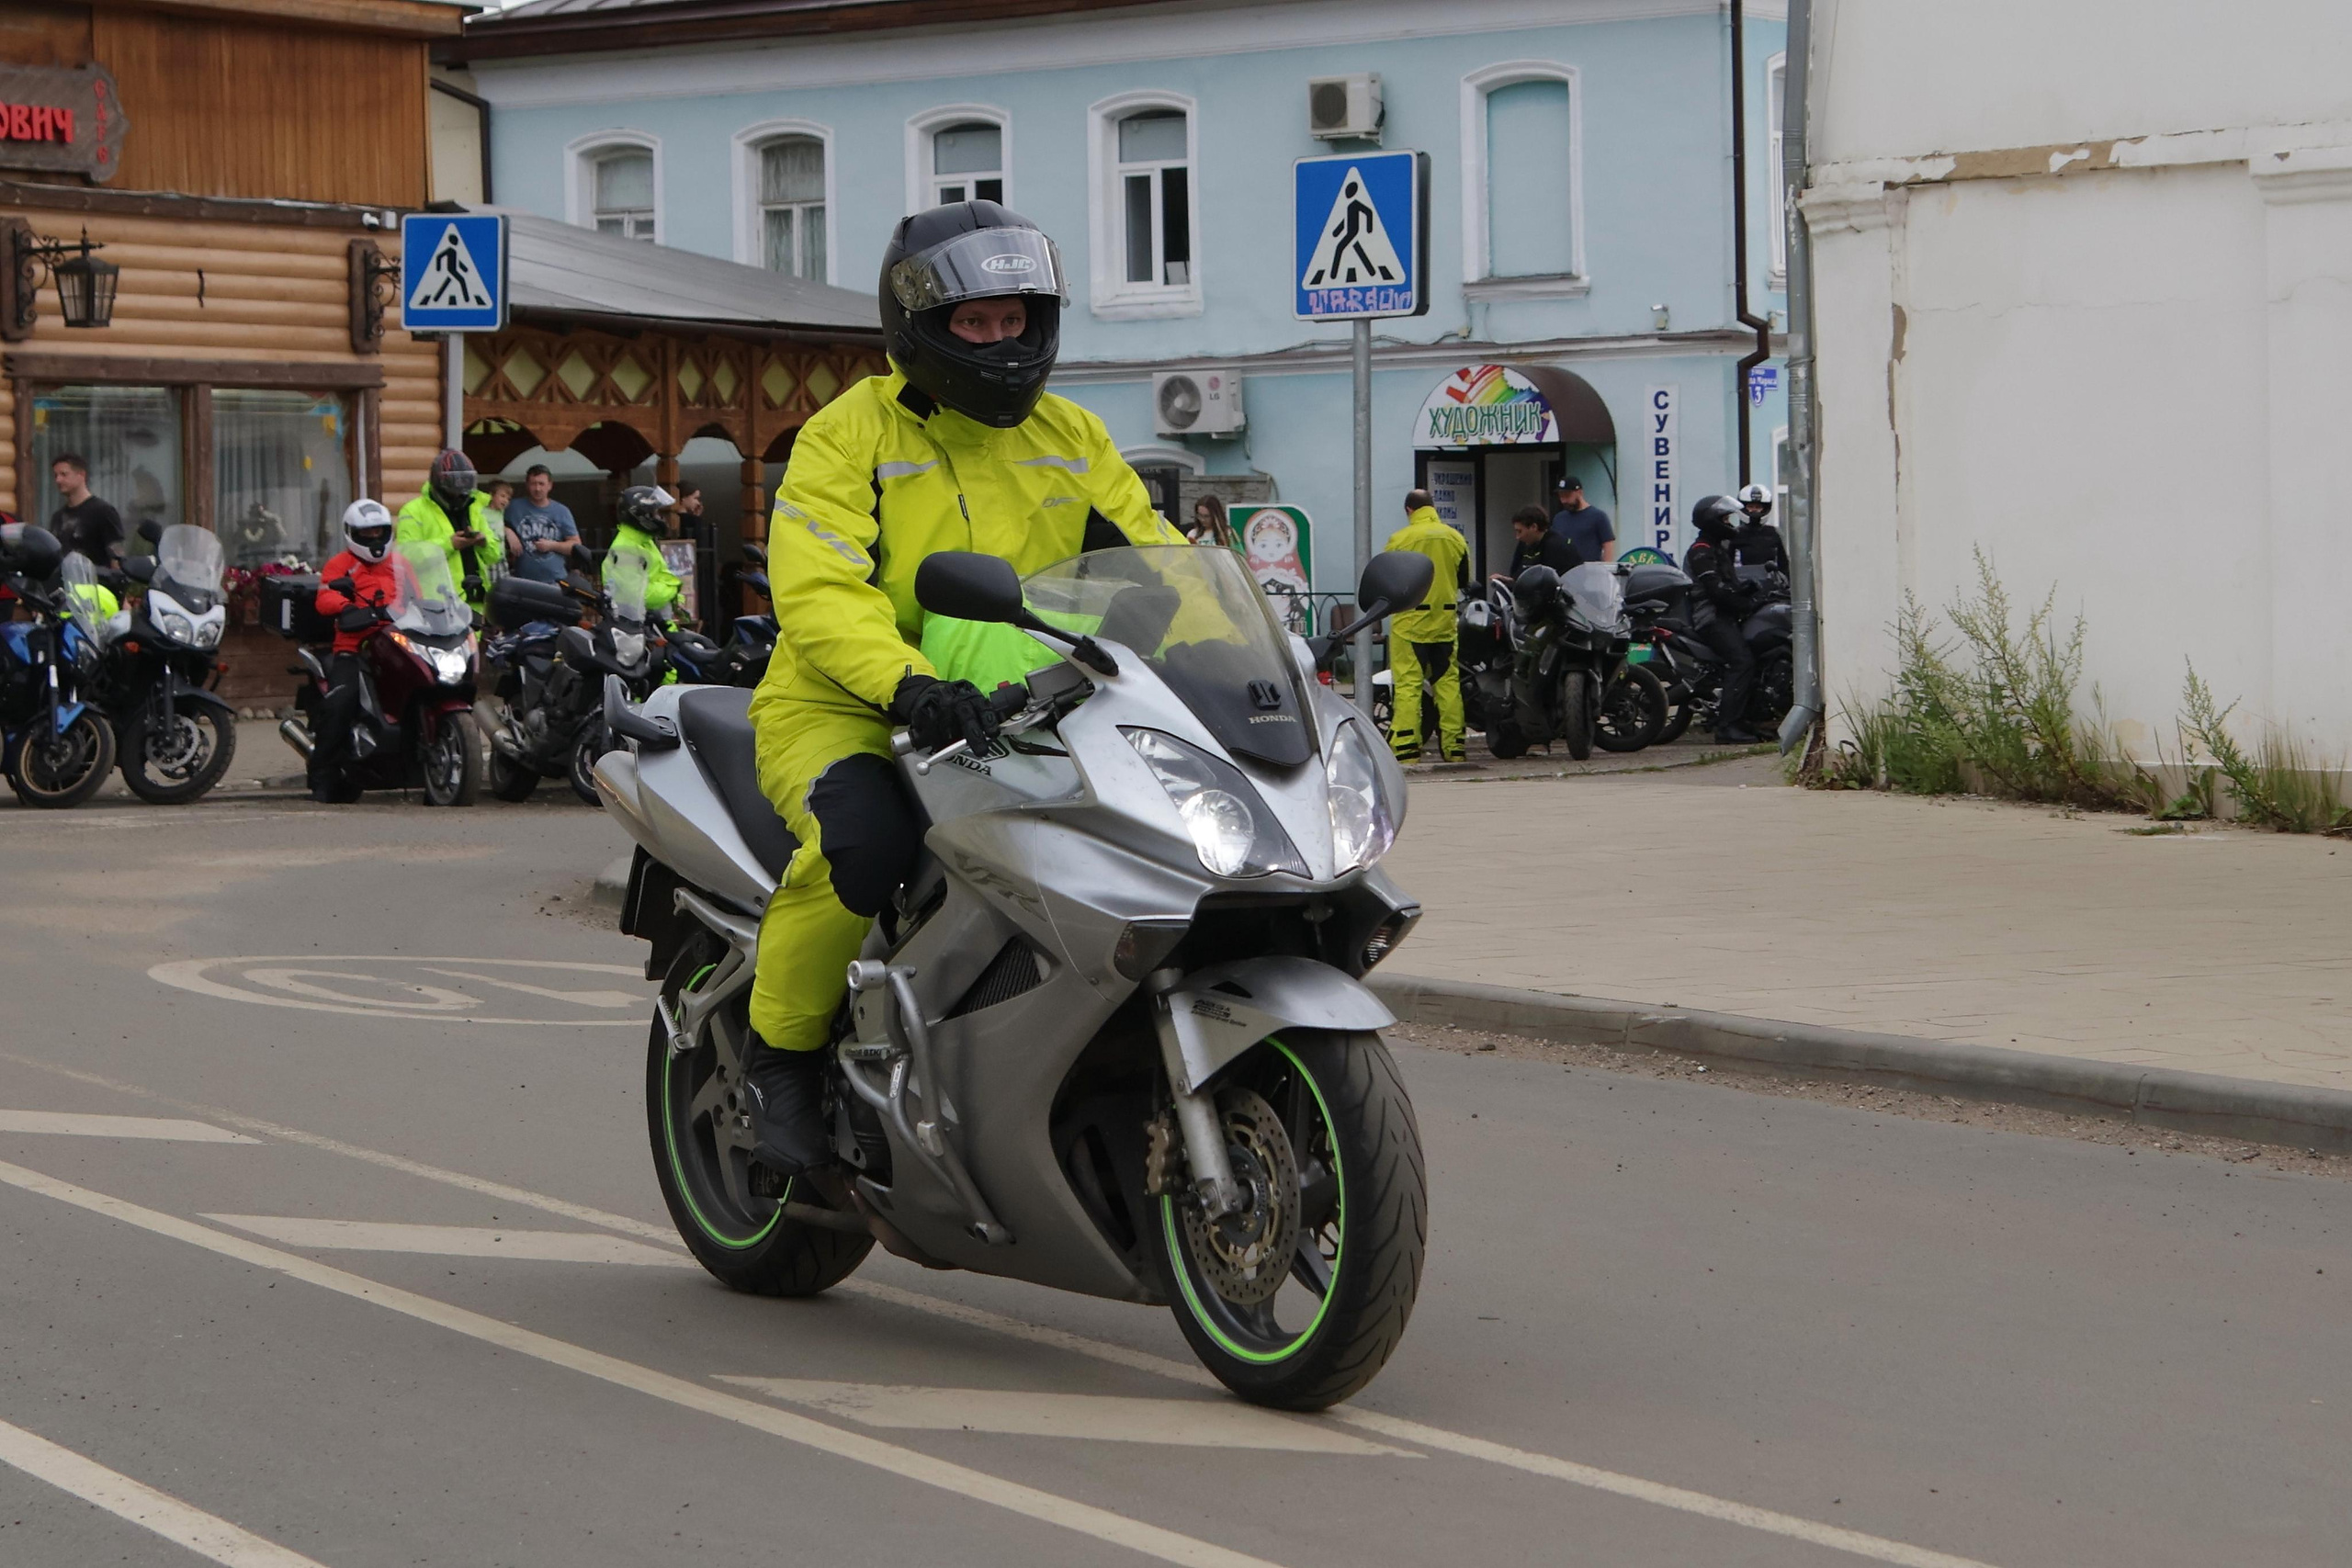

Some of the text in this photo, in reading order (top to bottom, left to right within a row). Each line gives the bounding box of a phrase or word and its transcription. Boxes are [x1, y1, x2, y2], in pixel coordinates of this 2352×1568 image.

[989, 258, 1030, 270] HJC
[1209, 392, 1220, 400] LG
[1755, 386, 1762, 403] 3
[1429, 402, 1542, 440] ХУДОЖНИК
[1654, 390, 1673, 559] СУВЕНИР
[1249, 715, 1297, 724] HONDA
